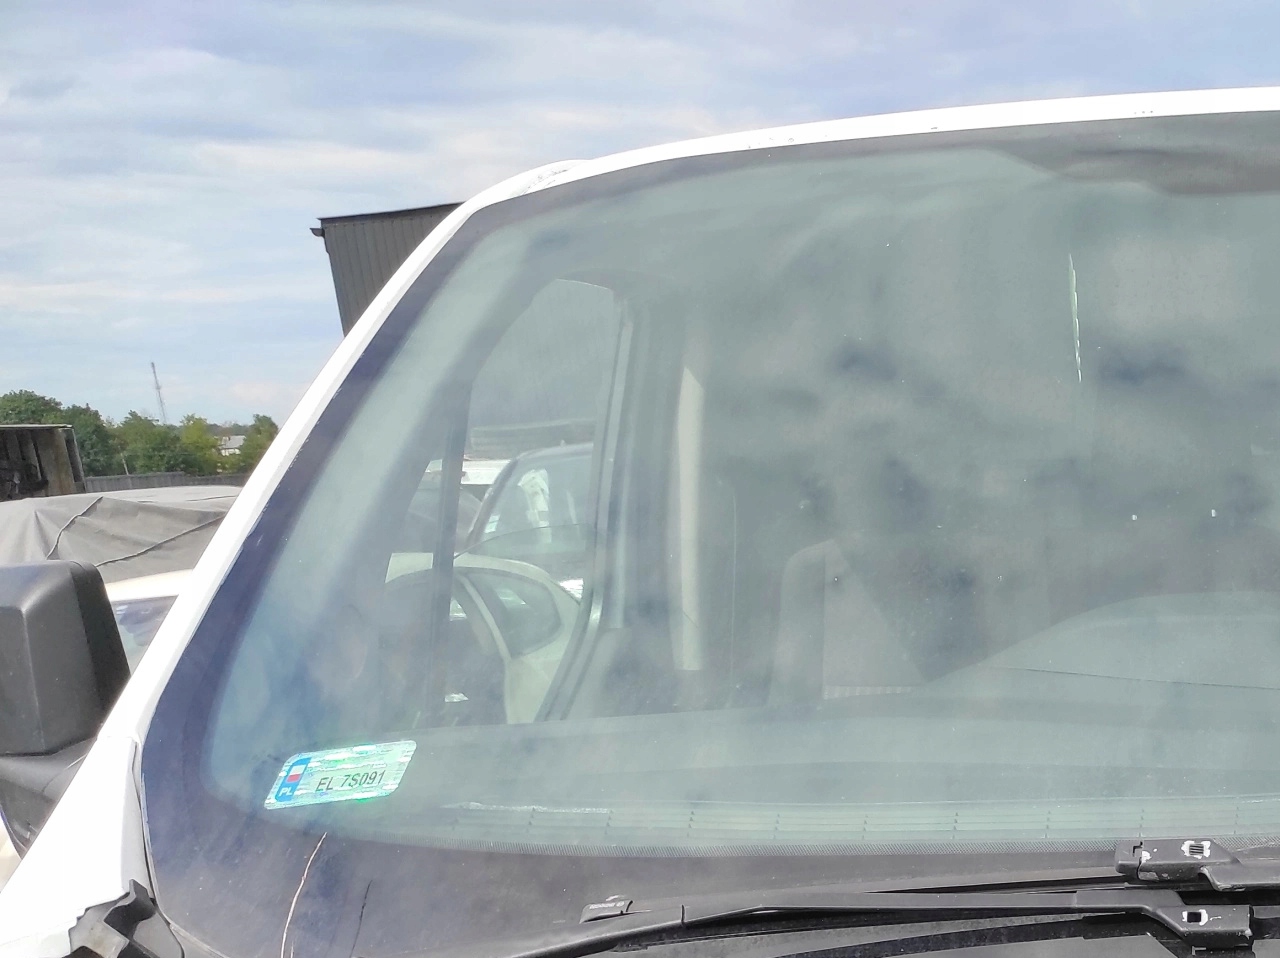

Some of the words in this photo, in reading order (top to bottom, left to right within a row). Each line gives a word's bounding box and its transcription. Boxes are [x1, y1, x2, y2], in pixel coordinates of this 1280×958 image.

[315, 776, 335, 792] EL
[341, 769, 386, 788] 7S091
[279, 787, 293, 797] PL
